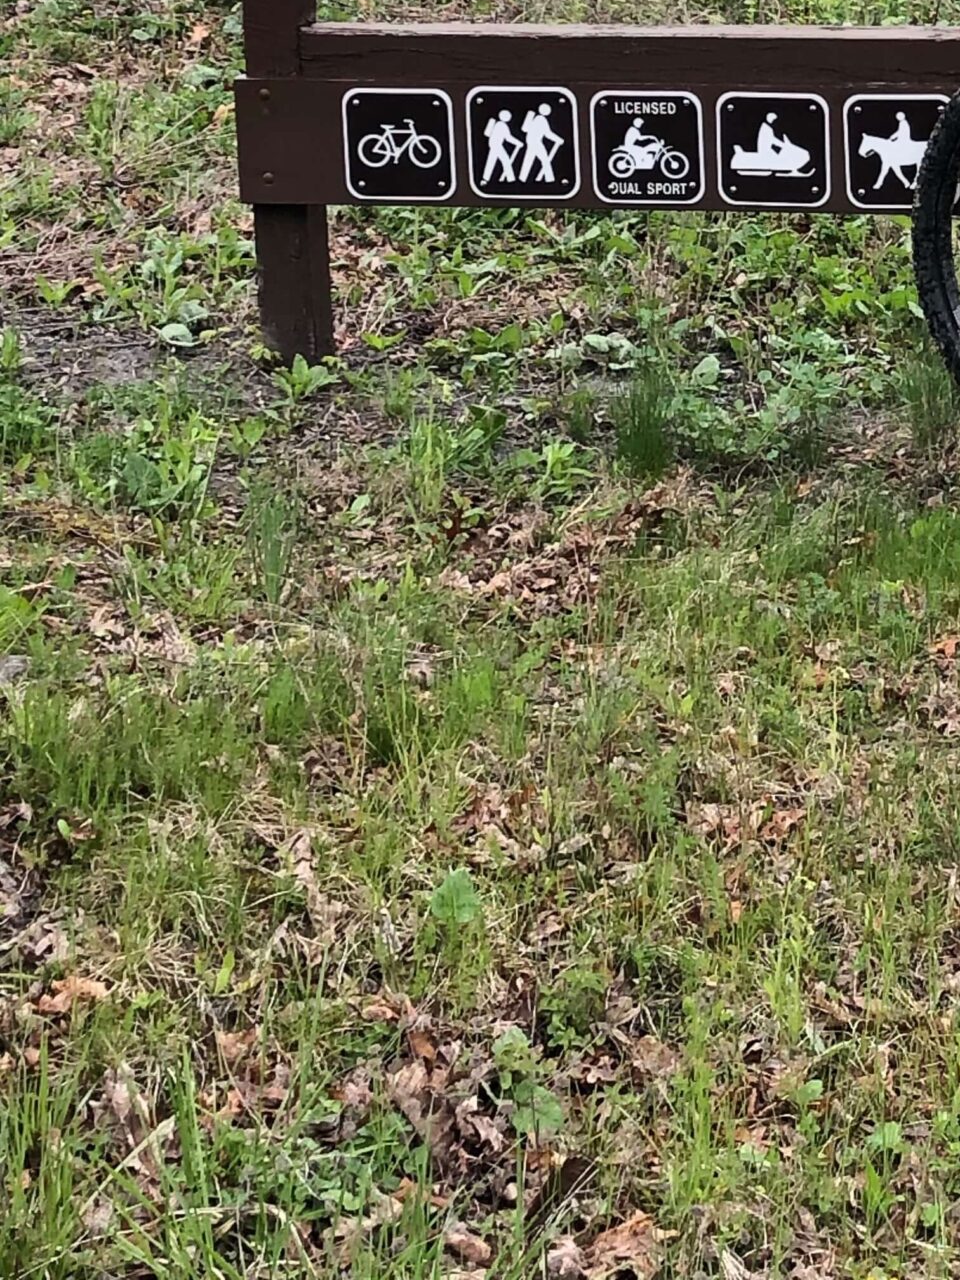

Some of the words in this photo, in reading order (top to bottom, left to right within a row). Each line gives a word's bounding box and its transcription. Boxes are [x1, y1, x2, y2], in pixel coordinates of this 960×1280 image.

[614, 101, 677, 115] LICENSED
[608, 181, 642, 196] DUAL
[646, 181, 688, 196] SPORT
